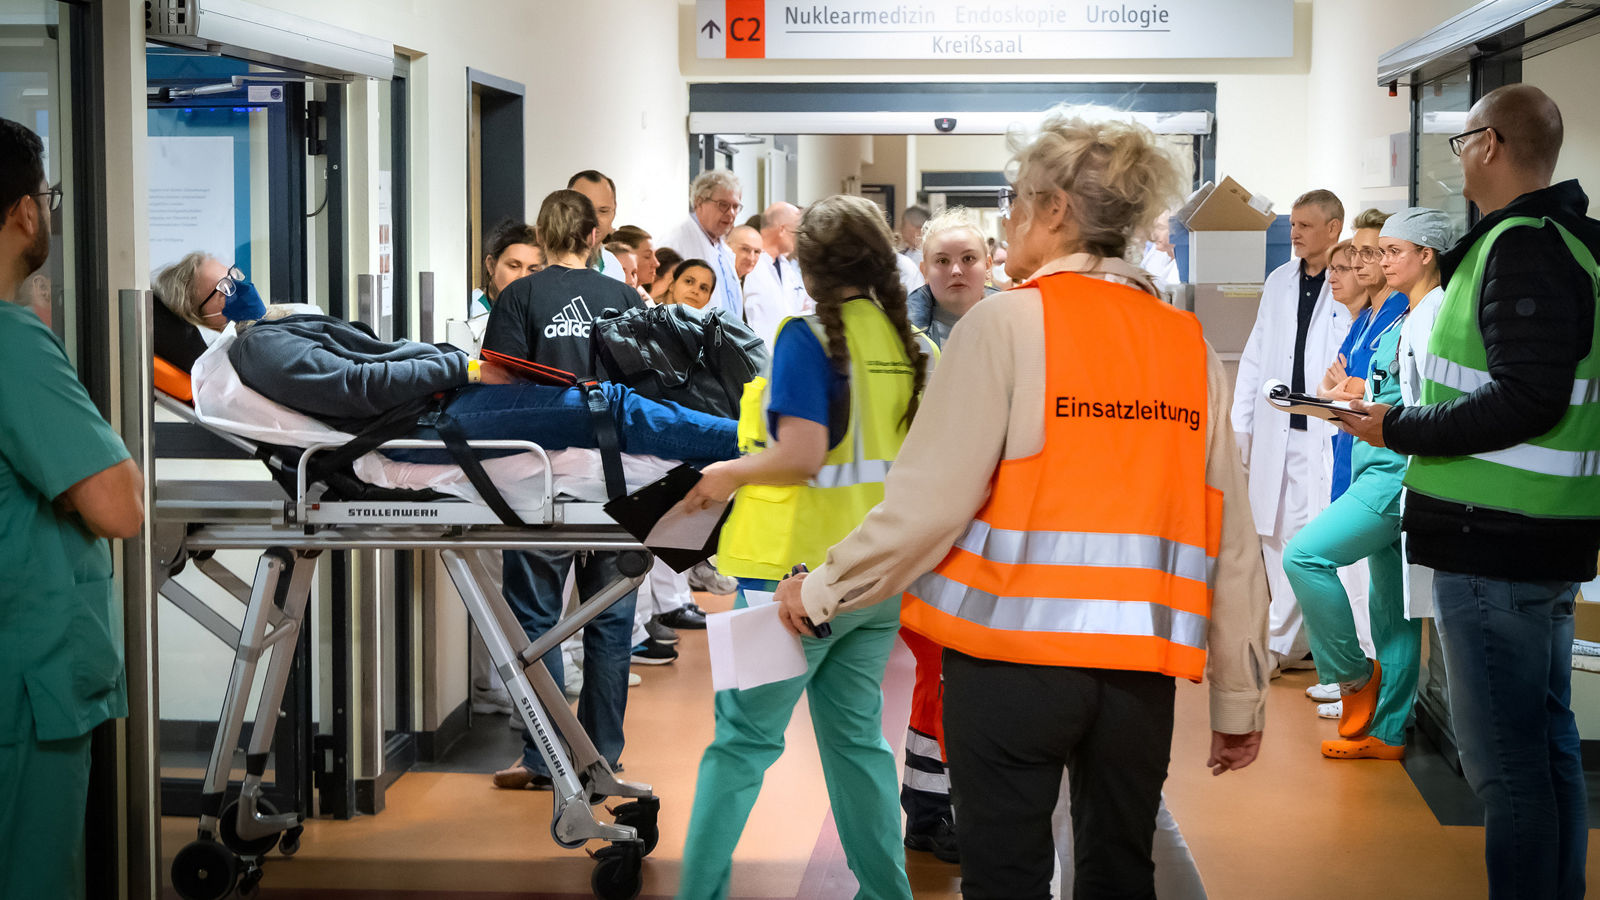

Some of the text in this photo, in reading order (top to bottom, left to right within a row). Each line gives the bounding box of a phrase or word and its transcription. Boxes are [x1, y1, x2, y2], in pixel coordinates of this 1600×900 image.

[785, 4, 1170, 28] Nuklearmedizin Endoskopie Urologie
[730, 17, 761, 42] C2
[932, 34, 1023, 54] Kreißsaal
[544, 320, 591, 339] adida
[1055, 396, 1200, 431] Einsatzleitung
